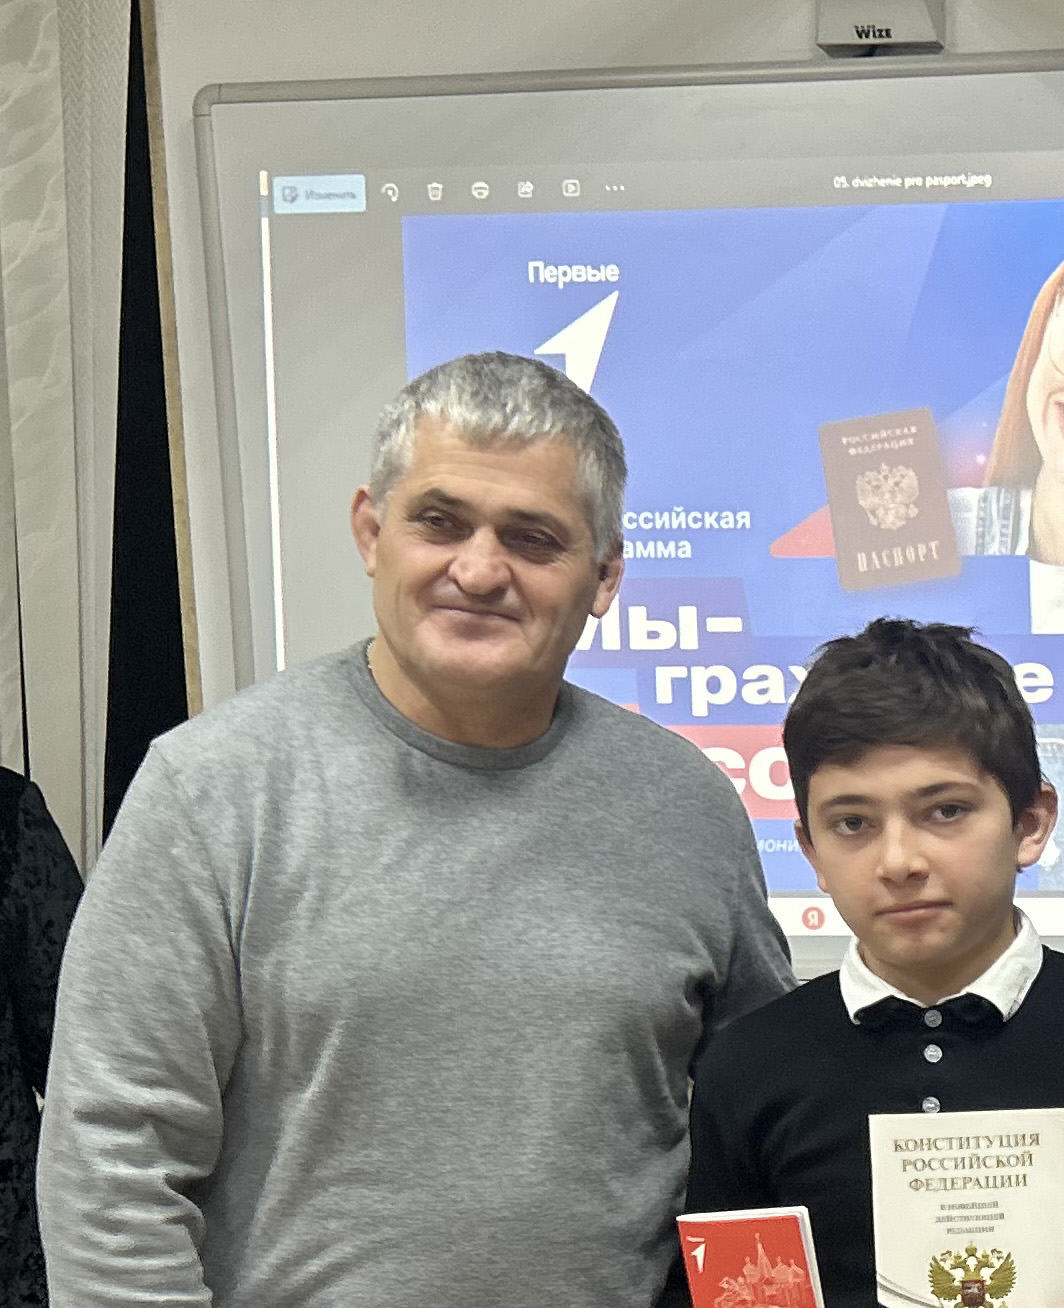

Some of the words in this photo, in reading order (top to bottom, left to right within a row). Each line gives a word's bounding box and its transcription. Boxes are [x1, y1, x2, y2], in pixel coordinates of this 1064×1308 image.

[904, 176, 923, 189] pro
[528, 260, 620, 290] Первые
[857, 540, 940, 573] ПАСПОРТ
[893, 1133, 1041, 1153] КОНСТИТУЦИЯ
[902, 1150, 1034, 1172] РОССИЙСКОЙ
[909, 1173, 1028, 1193] ФЕДЕРАЦИИ
